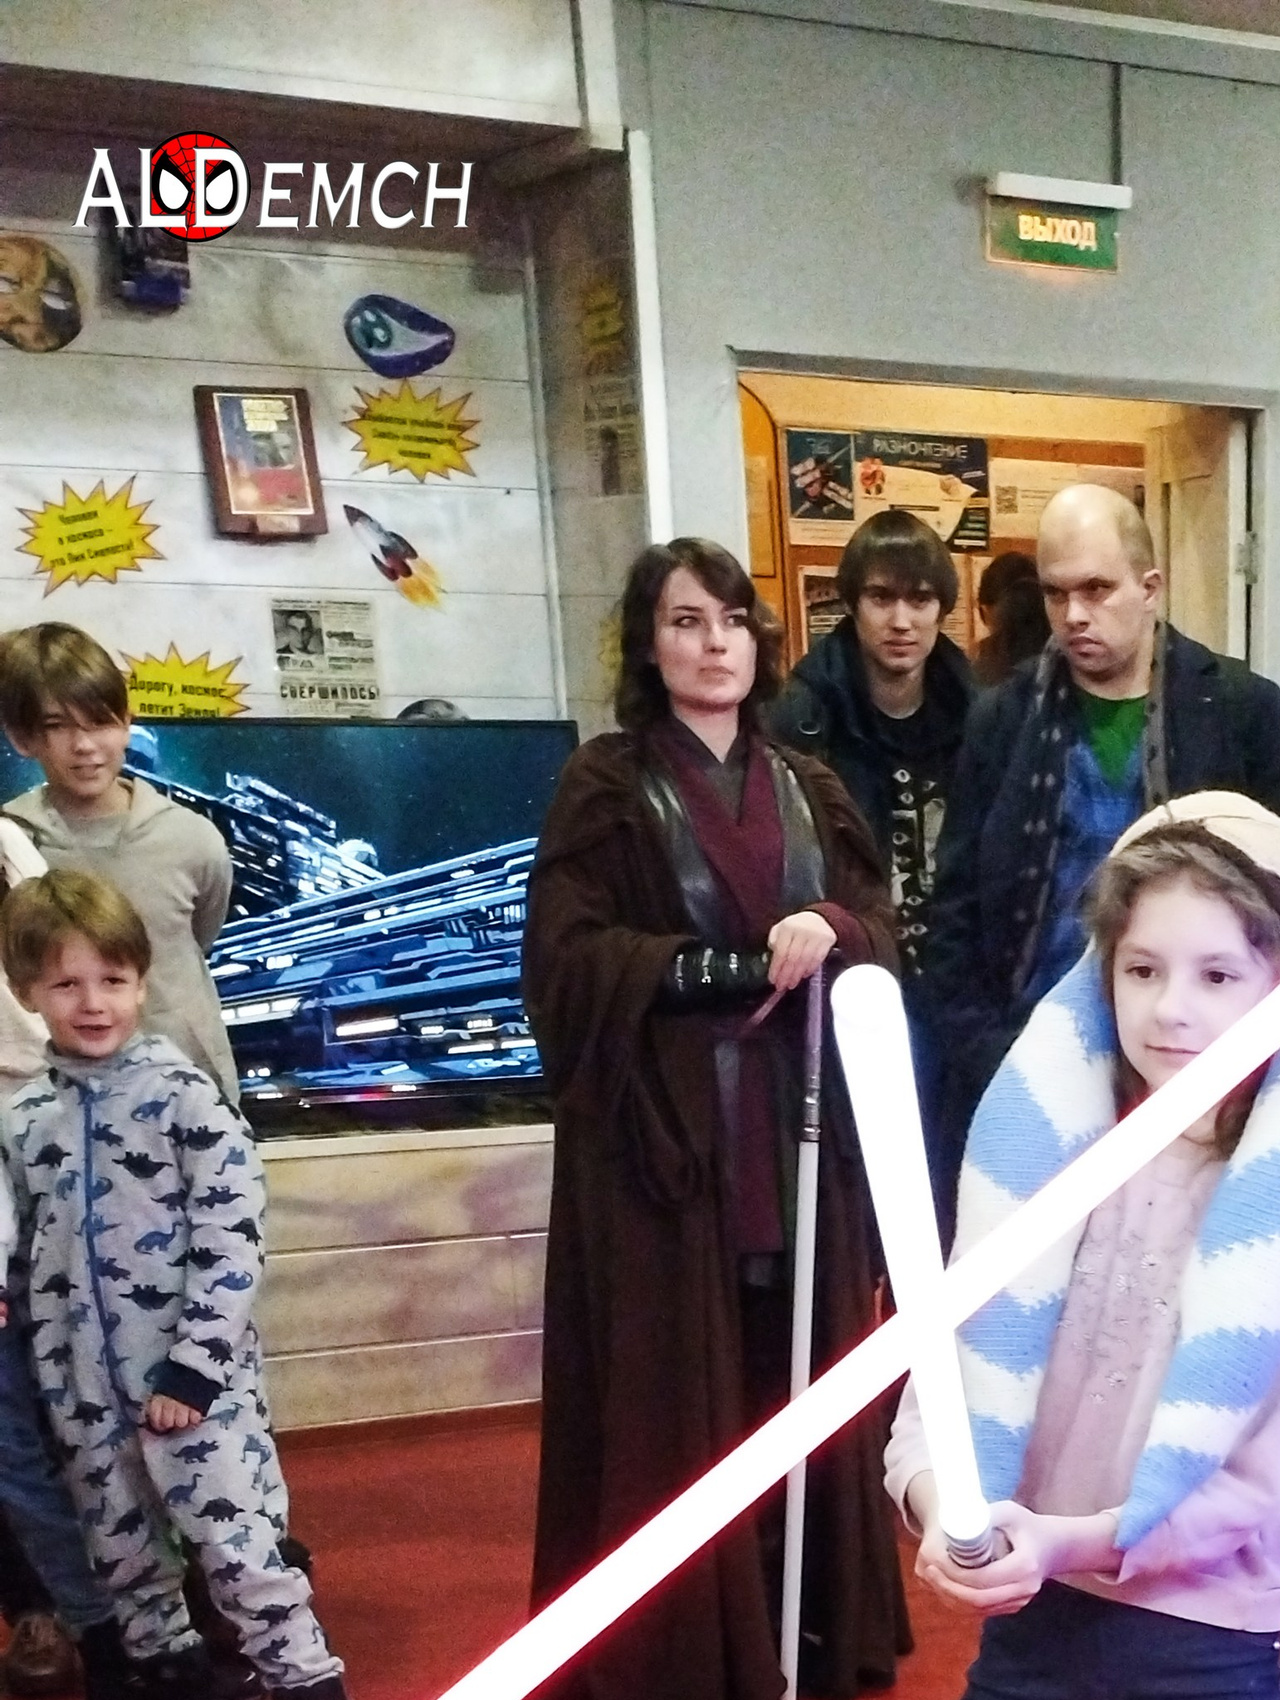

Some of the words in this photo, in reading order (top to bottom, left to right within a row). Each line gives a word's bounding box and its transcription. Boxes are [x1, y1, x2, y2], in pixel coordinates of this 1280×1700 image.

[1018, 215, 1097, 251] ВЫХОД
[872, 438, 968, 460] РАЗНОЧТЕНИЕ
[129, 673, 178, 696] Дорогу,
[139, 703, 174, 715] летит
